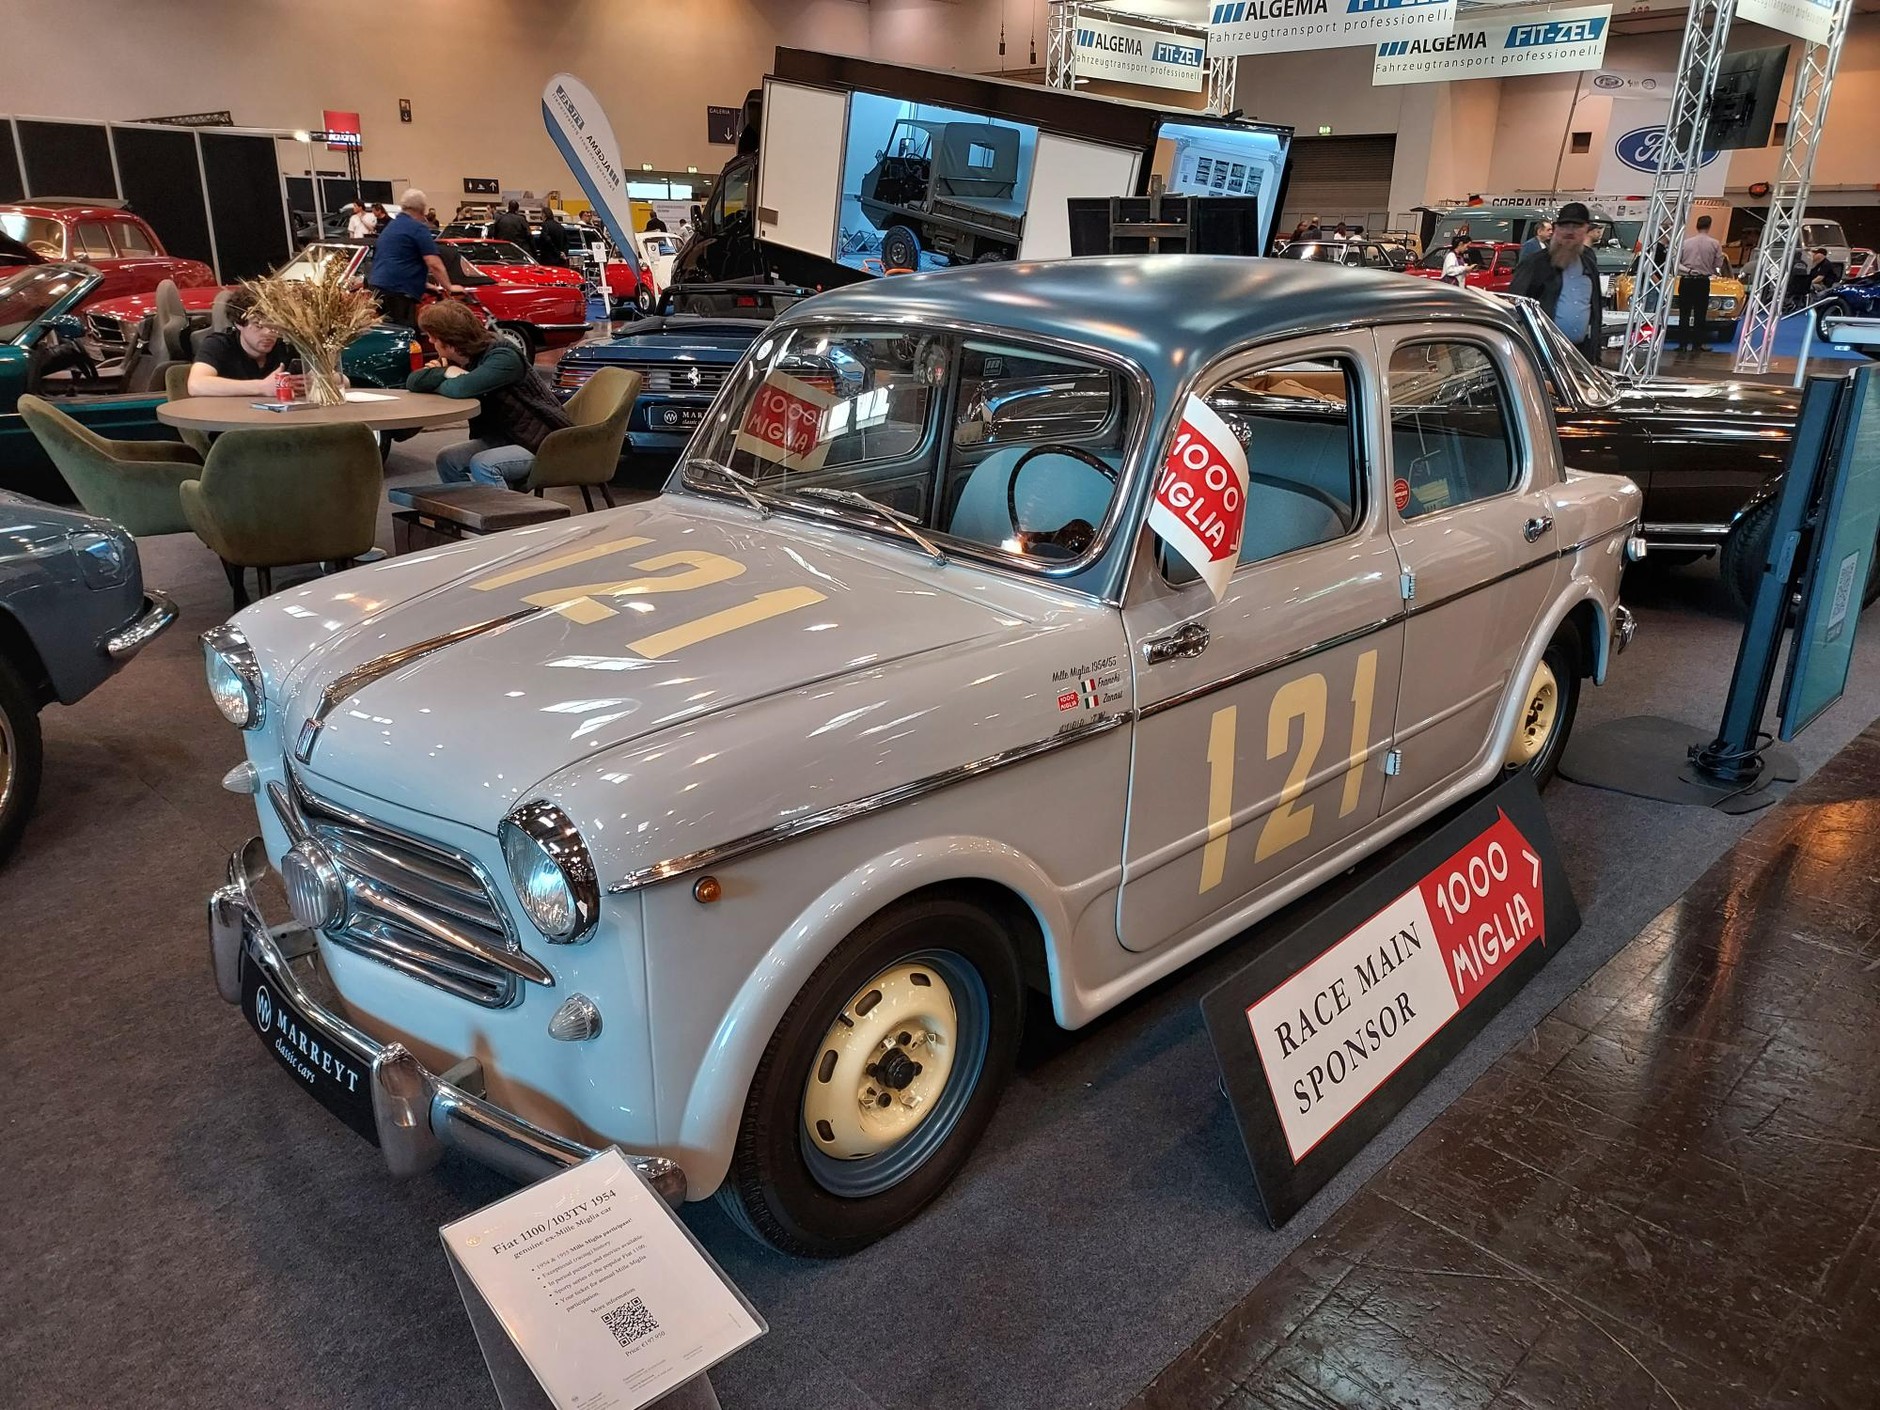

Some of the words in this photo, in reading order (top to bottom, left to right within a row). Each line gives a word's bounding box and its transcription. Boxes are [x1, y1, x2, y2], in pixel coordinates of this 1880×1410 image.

[1210, 22, 1337, 43] Fahrzeugtransport
[1344, 10, 1452, 33] professionell.
[1245, 0, 1328, 21] ALGEMA
[1095, 33, 1142, 56] ALGEMA
[1157, 45, 1199, 66] FIT-ZEL
[1375, 56, 1495, 73] Fahrzeugtransport
[1501, 46, 1602, 65] professionell.
[1409, 31, 1487, 54] ALGEMA
[1515, 21, 1595, 45] FIT-ZEL
[1077, 54, 1147, 72] ahrzeugtransport
[762, 390, 816, 425] 1000
[1174, 433, 1238, 512] 1000
[469, 536, 829, 660] 121
[1070, 664, 1090, 679] Miglia
[1091, 656, 1117, 672] 1954/55
[1199, 649, 1377, 894] 121
[1436, 841, 1508, 924] 1000
[1451, 892, 1534, 995] MIGLIA
[1274, 978, 1352, 1060] RACE
[1353, 921, 1423, 995] MAIN
[275, 1037, 298, 1067] classic
[297, 1064, 315, 1084] cars
[277, 1008, 359, 1092] MARREYT
[1293, 992, 1417, 1114] SPONSOR
[492, 1239, 518, 1254] Fiat
[520, 1202, 586, 1240] 1100/103TV
[591, 1189, 615, 1206] 1954
[513, 1240, 543, 1259] genuine
[545, 1225, 574, 1242] ex-Mille
[575, 1213, 599, 1227] Miglia
[600, 1206, 611, 1214] car
[569, 1243, 584, 1251] Mille
[584, 1234, 602, 1244] Miglia
[559, 1293, 574, 1302] Your
[614, 1264, 628, 1273] Mille
[628, 1255, 646, 1265] Miglia
[592, 1255, 602, 1263] and
[589, 1304, 605, 1313] More
[605, 1288, 635, 1306] information
